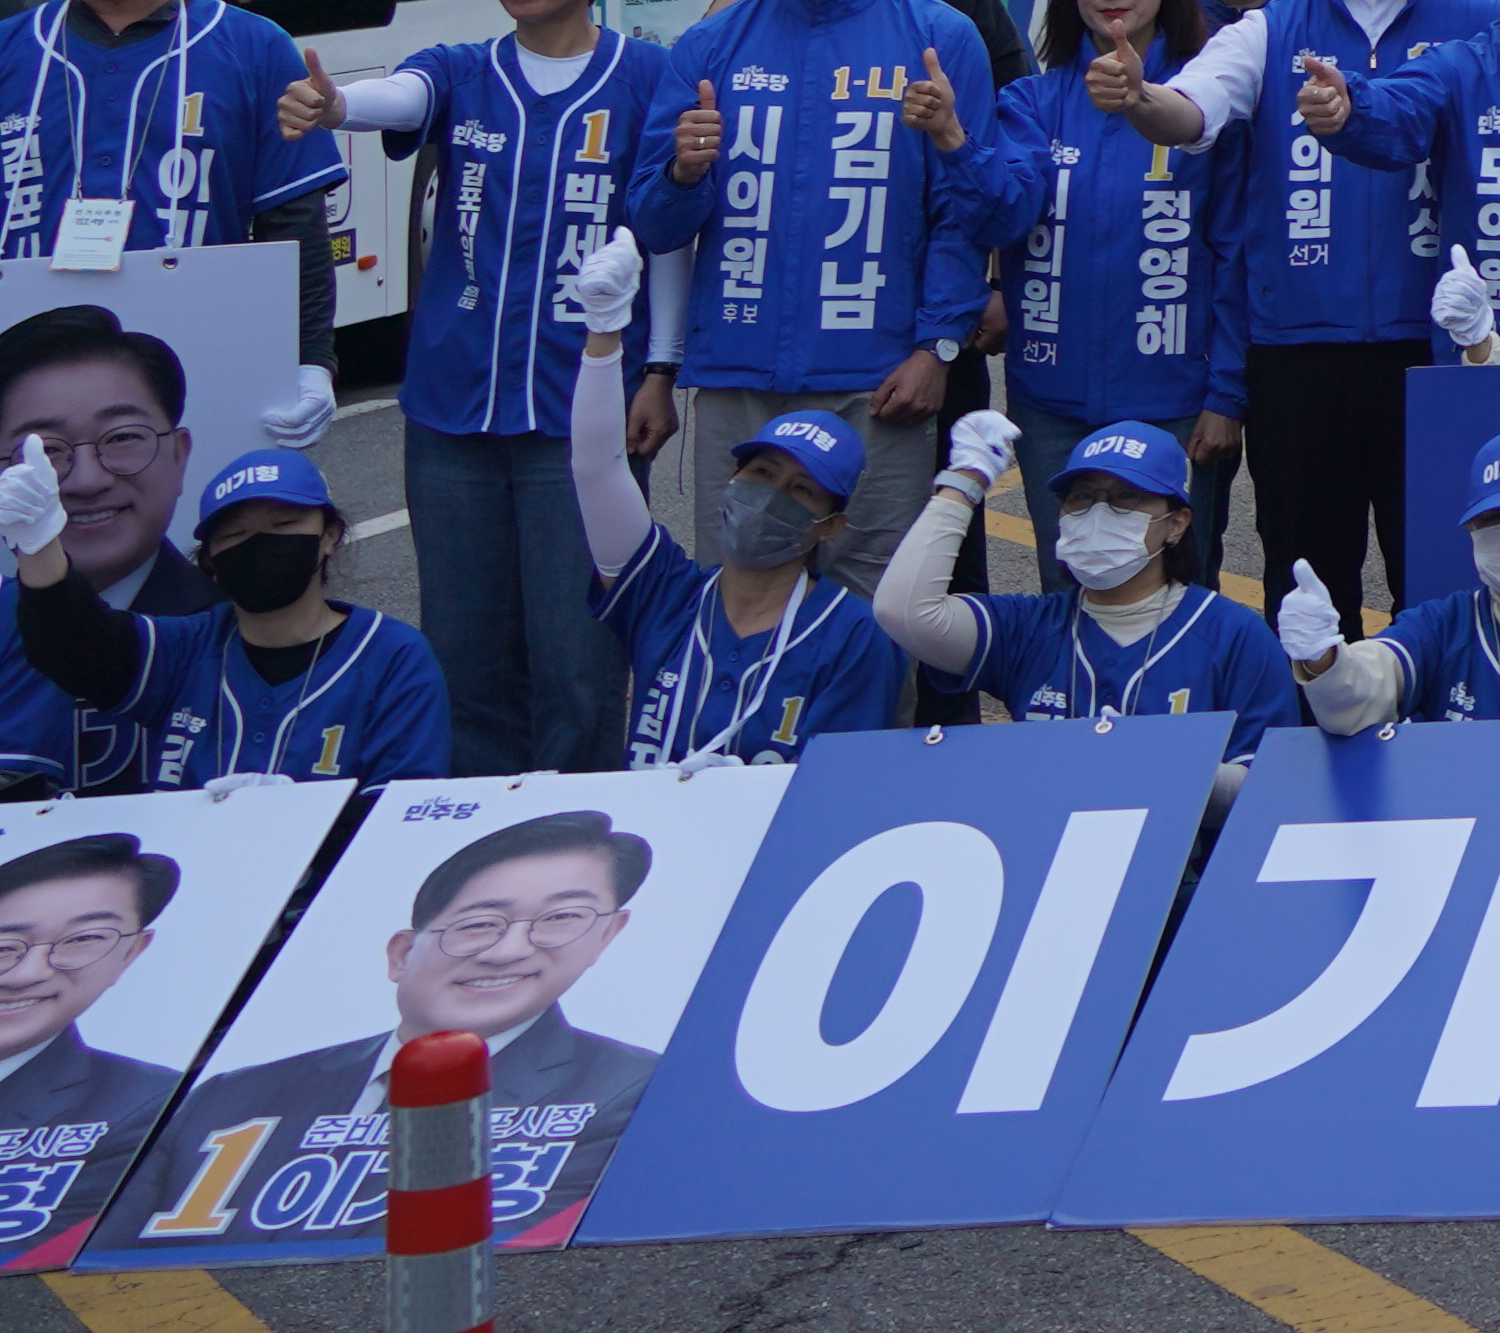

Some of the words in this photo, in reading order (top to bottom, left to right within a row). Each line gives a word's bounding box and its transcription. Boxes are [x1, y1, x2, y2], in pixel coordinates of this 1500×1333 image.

[731, 73, 790, 93] 민주당
[831, 65, 909, 101] 1-나
[181, 91, 205, 137] 1
[452, 124, 508, 153] 민주당
[575, 108, 610, 164] 1
[719, 105, 783, 300] 시의원
[819, 111, 894, 331] 김기남
[1136, 189, 1192, 357] 정영혜
[1288, 244, 1330, 266] 선거
[721, 303, 759, 325] 후보
[1022, 341, 1058, 366] 선거
[774, 420, 840, 453] 이기형
[1082, 435, 1149, 461] 이기형
[213, 463, 281, 501] 이기형
[771, 695, 806, 746] 1
[310, 723, 346, 776] 1
[402, 800, 481, 822] 민주당
[301, 1114, 391, 1149] 준비
[489, 1102, 597, 1139] 포시장
[138, 1115, 283, 1240] 1
